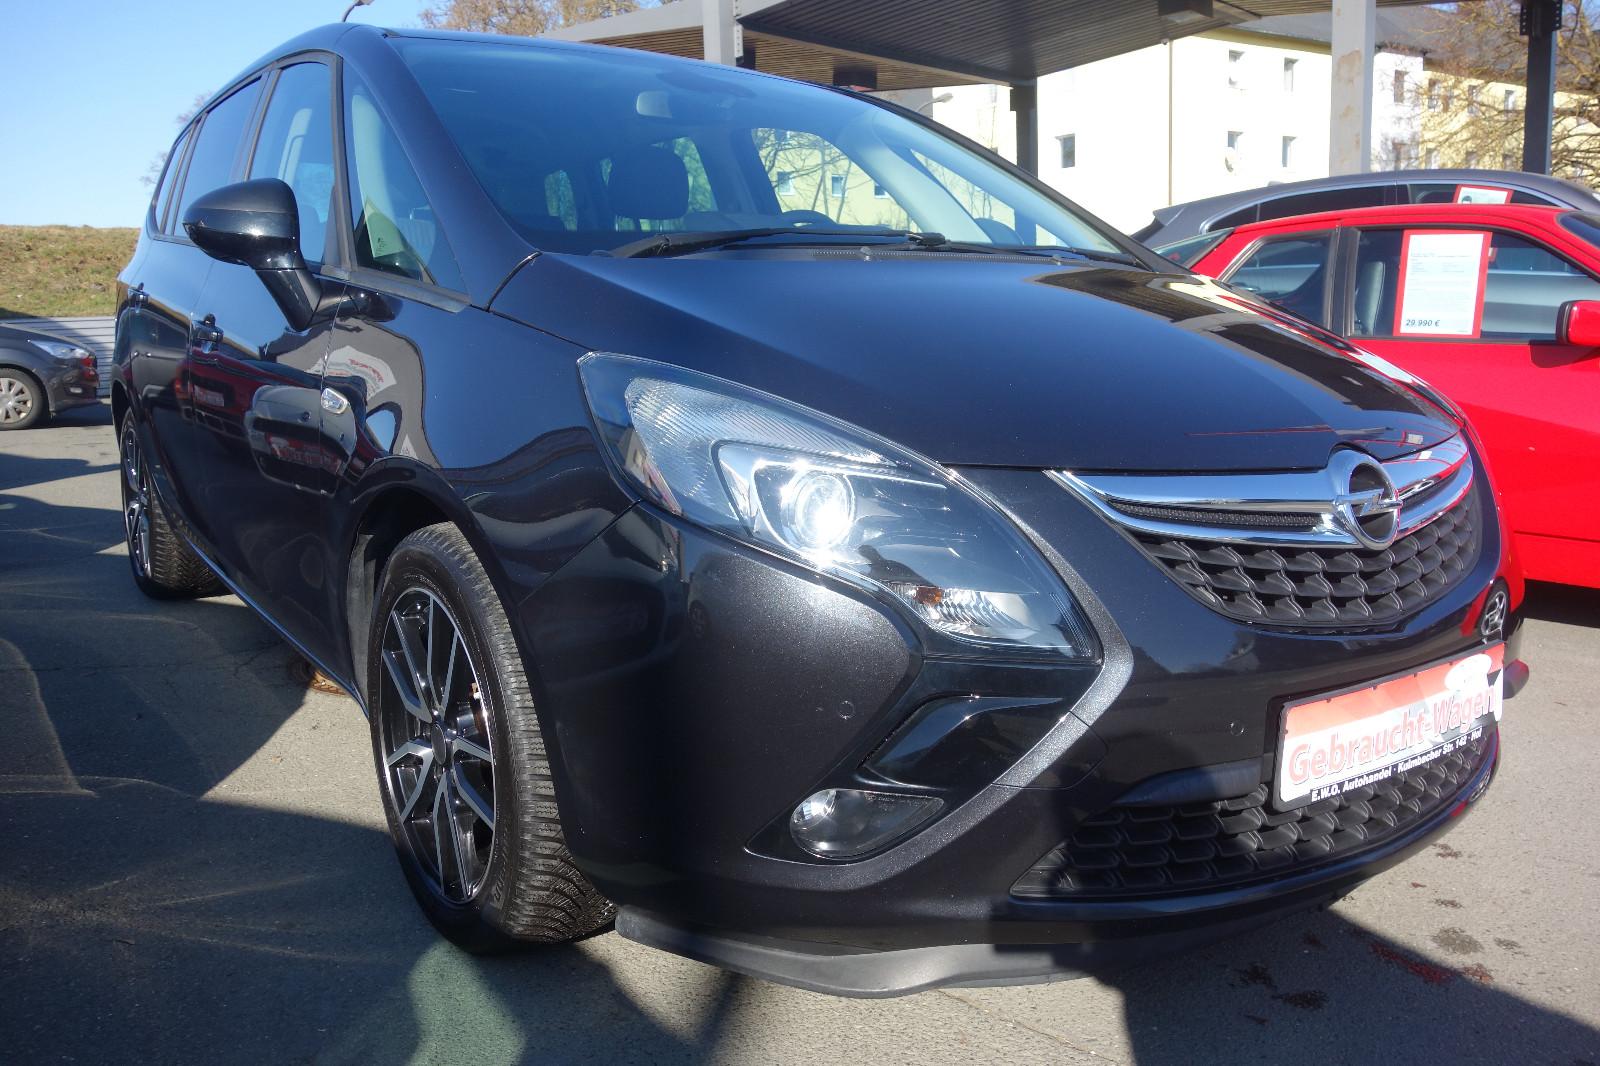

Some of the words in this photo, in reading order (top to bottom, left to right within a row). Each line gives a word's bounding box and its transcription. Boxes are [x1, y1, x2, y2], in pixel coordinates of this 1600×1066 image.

[1406, 319, 1433, 328] 29.990
[1434, 319, 1441, 327] €
[1289, 684, 1495, 785] Gebraucht-Wagen
[1311, 785, 1341, 802] E.W.O.
[1343, 766, 1392, 793] Autohandel
[1397, 748, 1442, 774] Kulmbacher
